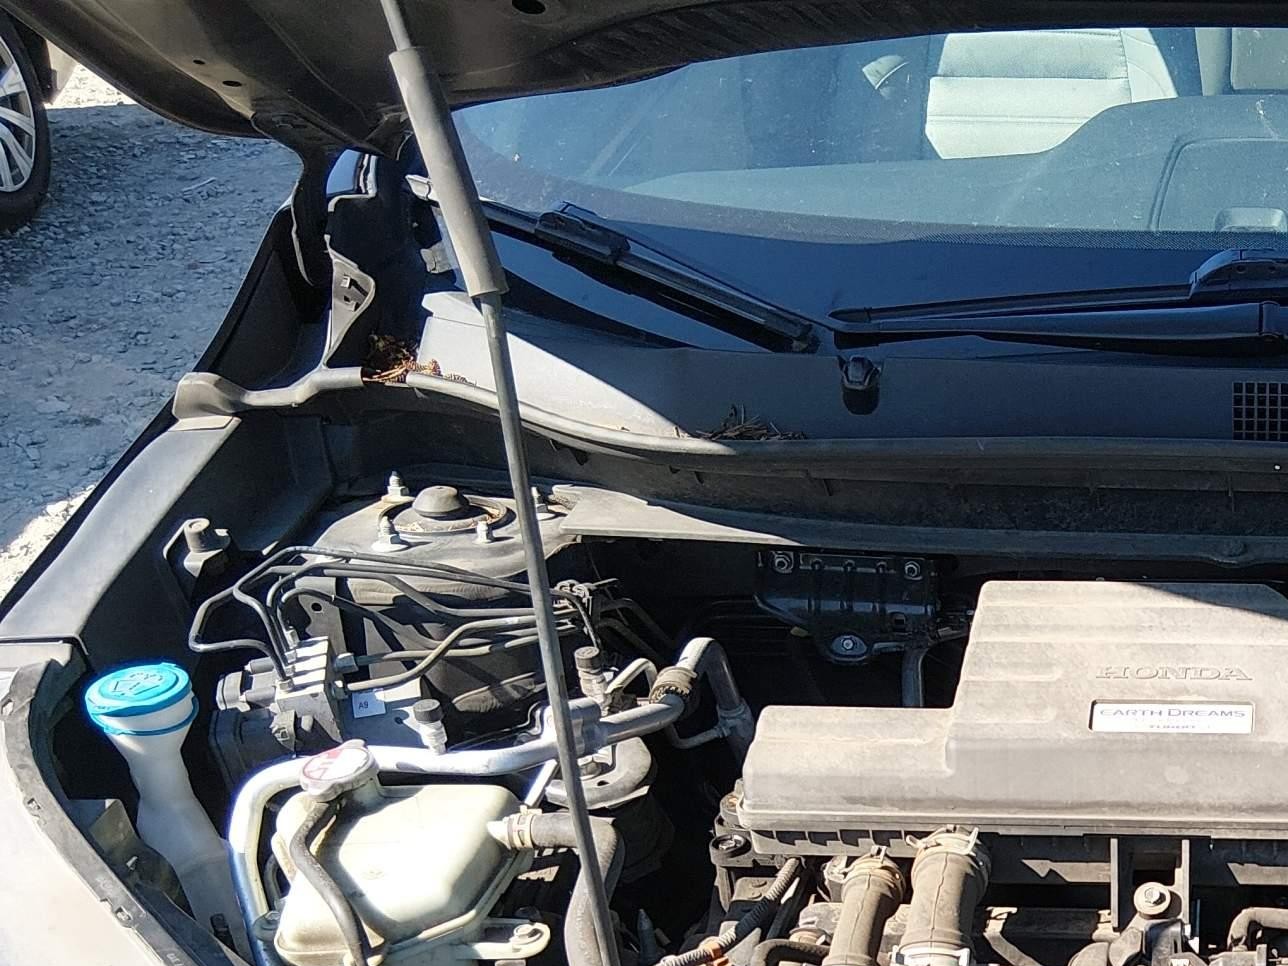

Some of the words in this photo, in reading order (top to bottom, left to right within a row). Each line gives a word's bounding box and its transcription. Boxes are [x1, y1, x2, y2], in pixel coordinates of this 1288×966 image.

[1095, 664, 1253, 681] HONDA
[358, 701, 369, 710] A9
[1100, 708, 1163, 717] EARTH
[1167, 708, 1246, 718] DREAMS
